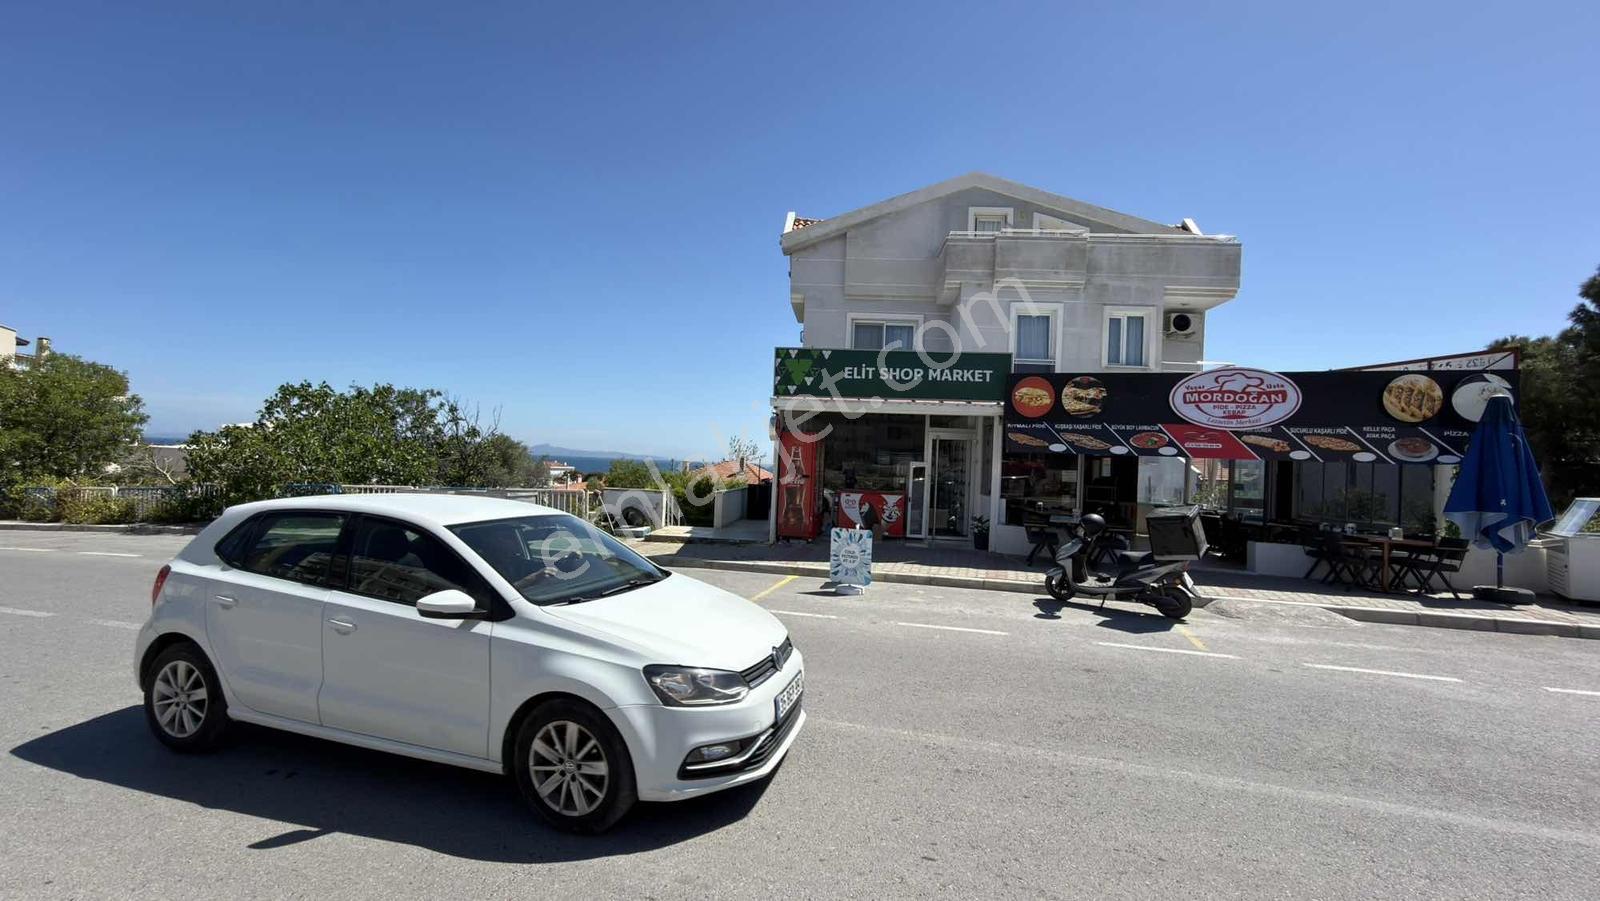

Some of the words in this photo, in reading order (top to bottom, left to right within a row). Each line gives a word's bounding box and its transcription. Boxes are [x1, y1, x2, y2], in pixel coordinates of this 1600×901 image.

[844, 364, 875, 379] ELİT
[880, 367, 924, 381] SHOP
[928, 369, 993, 382] MARKET
[1185, 391, 1283, 403] MORDOĞAN
